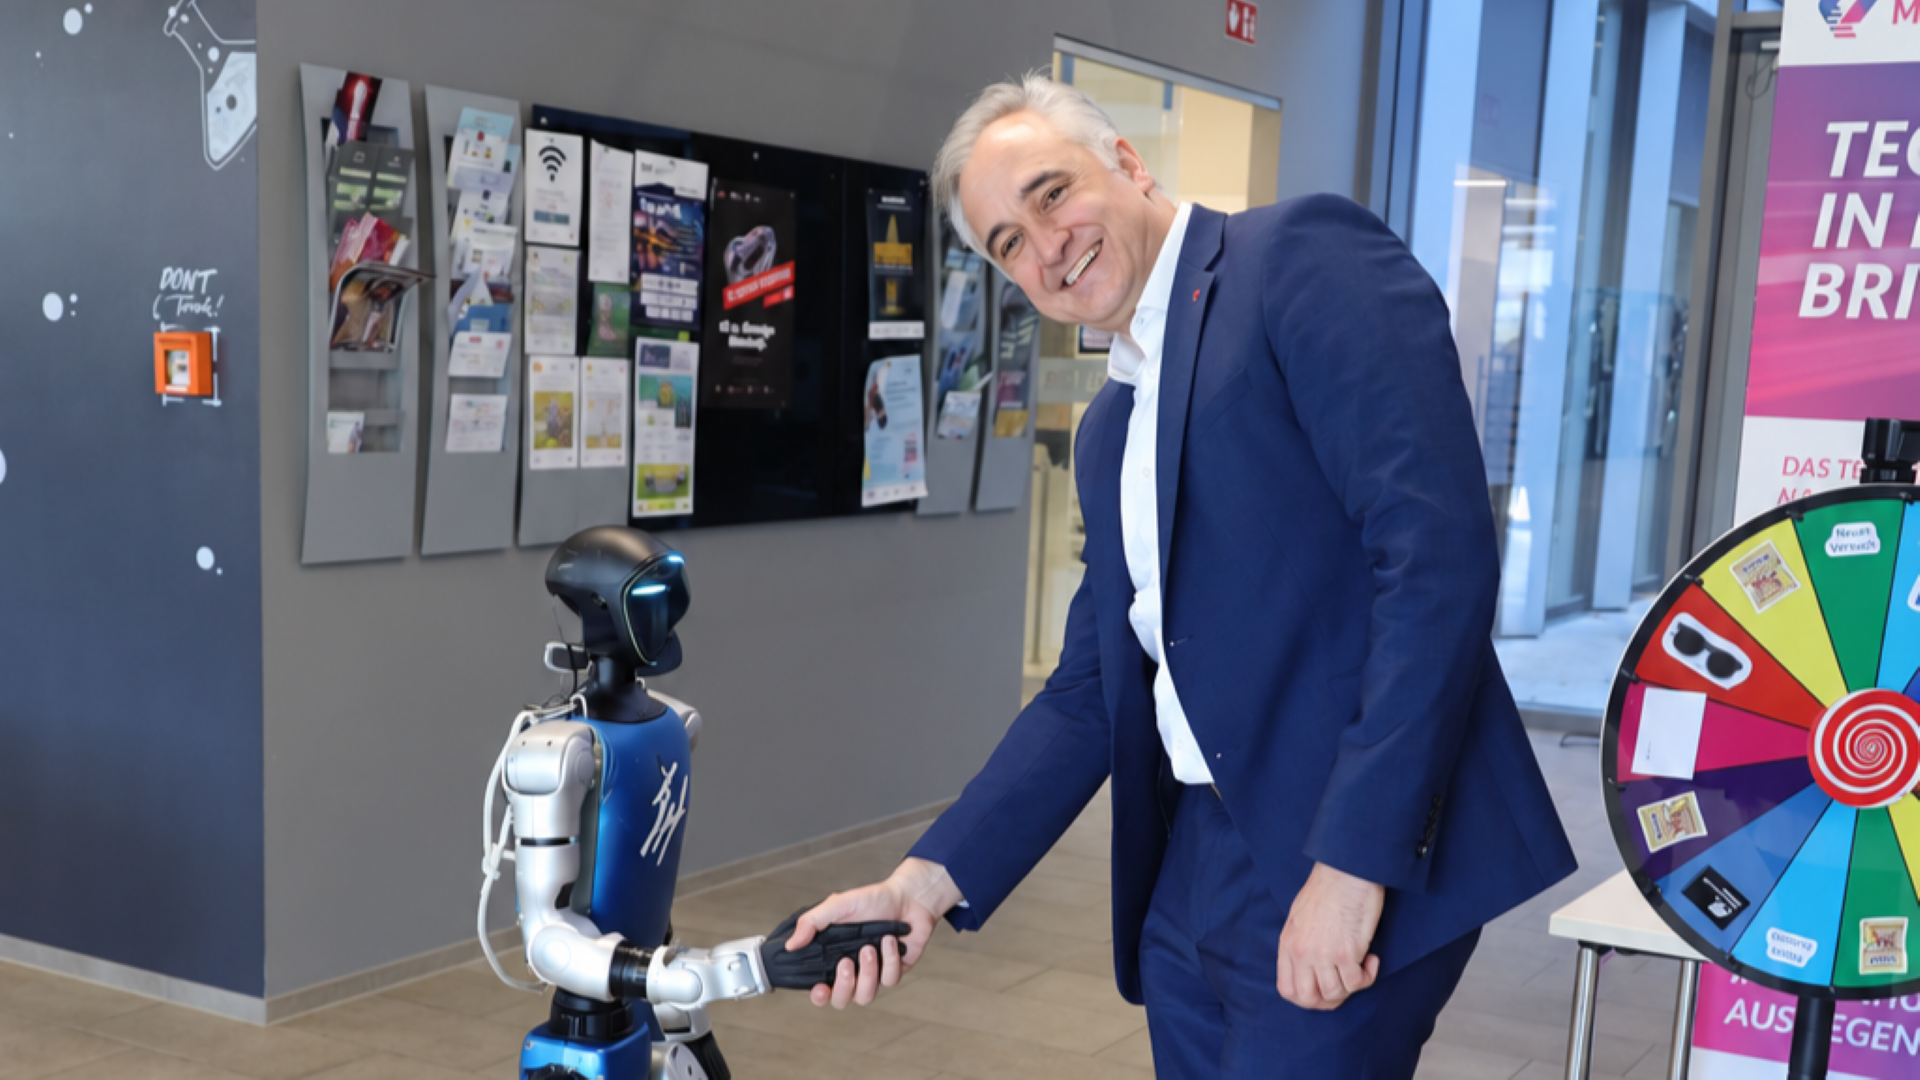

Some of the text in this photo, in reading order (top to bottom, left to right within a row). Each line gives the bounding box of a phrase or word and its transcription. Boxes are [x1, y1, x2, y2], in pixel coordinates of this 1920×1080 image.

[1812, 192, 1894, 249] IN
[1782, 456, 1865, 480] DAS TE
